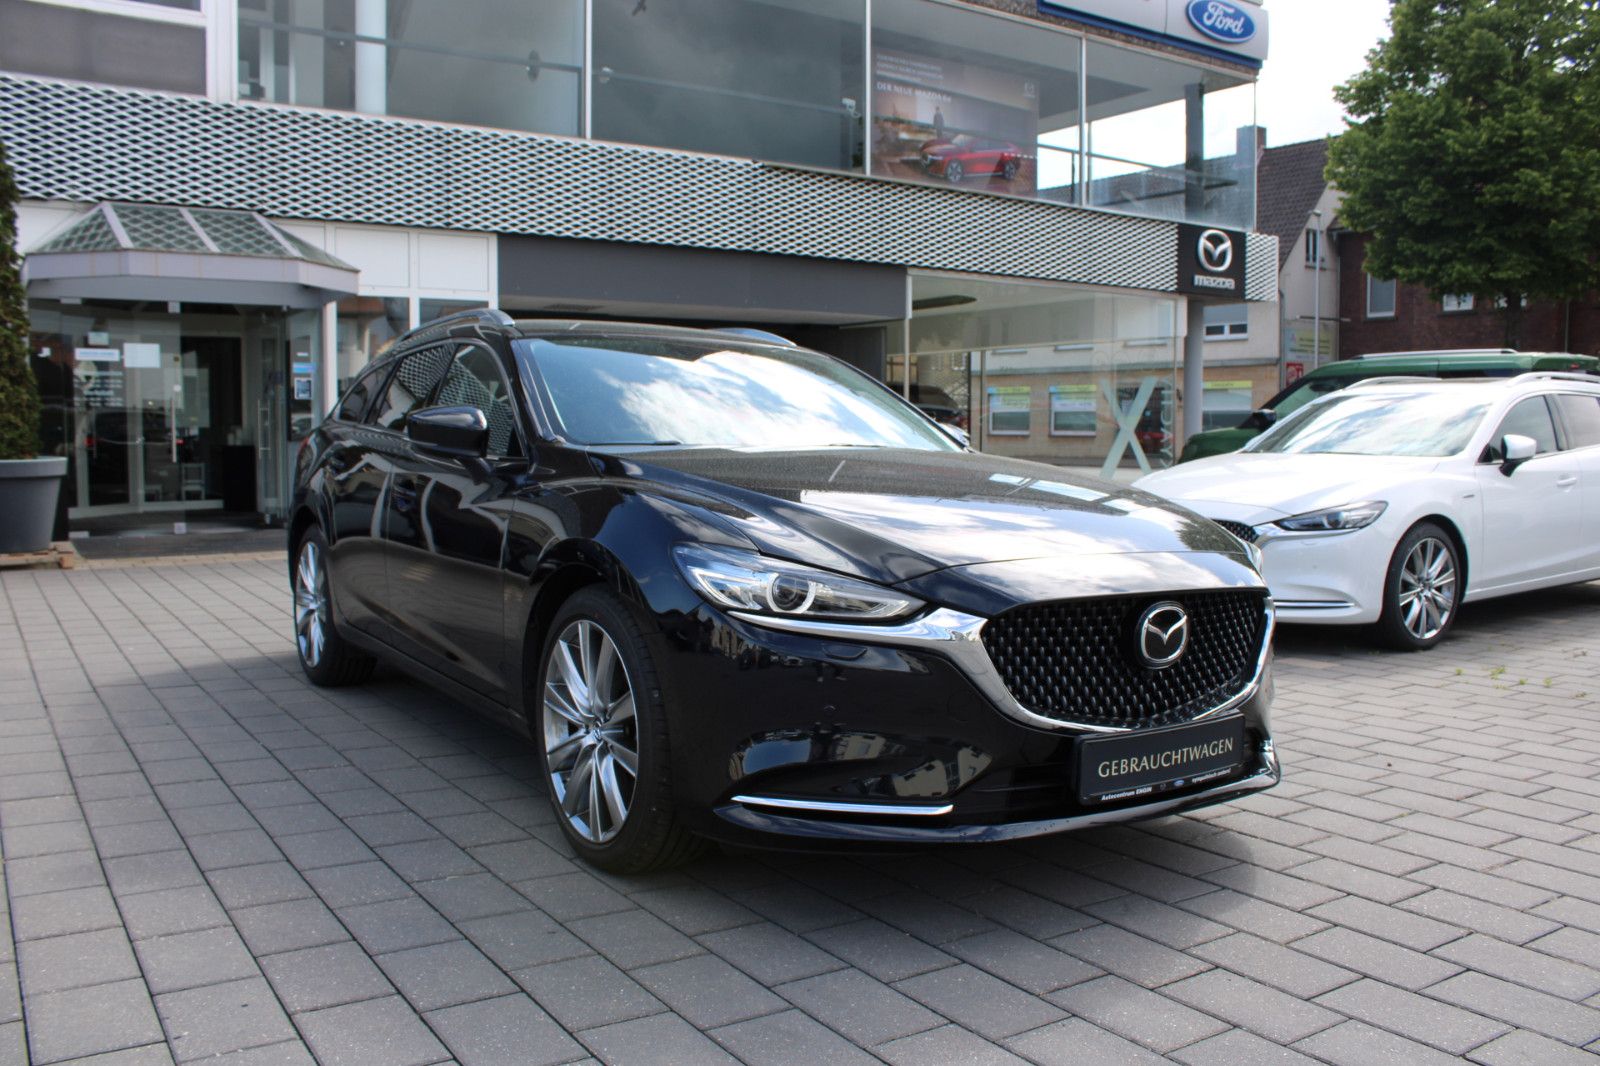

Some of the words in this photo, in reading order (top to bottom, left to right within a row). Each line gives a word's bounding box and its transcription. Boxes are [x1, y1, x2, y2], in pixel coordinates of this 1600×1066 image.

[1203, 1, 1244, 34] Ford
[1194, 274, 1235, 290] mazda
[1098, 737, 1234, 778] GEBRAUCHTWAGEN
